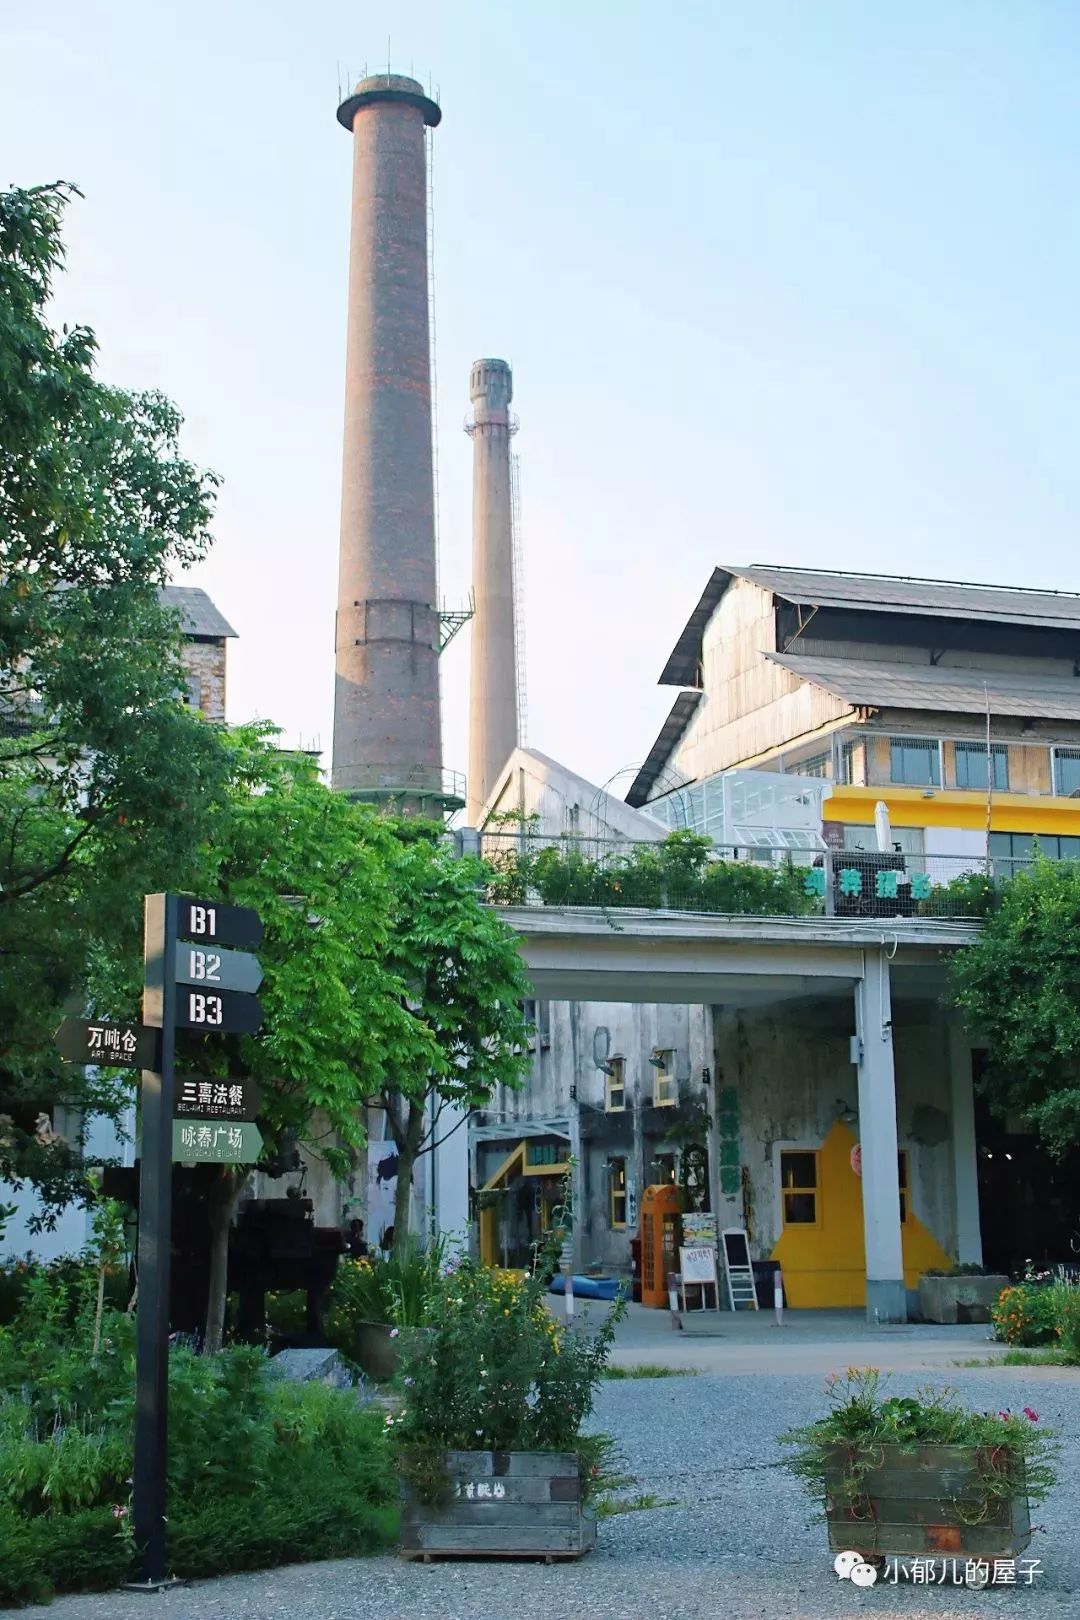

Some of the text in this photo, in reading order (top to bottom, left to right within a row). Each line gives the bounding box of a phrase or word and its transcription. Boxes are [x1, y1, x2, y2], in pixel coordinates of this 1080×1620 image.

[190, 906, 216, 936] B1
[189, 951, 221, 981] B2
[189, 994, 222, 1025] B3
[88, 1027, 137, 1052] 万吨仓
[91, 1050, 132, 1061] ART SPACE
[182, 1082, 243, 1106] 三喜法餐
[206, 1105, 247, 1115] RESTAURANT
[182, 1126, 243, 1149] 咏春广场
